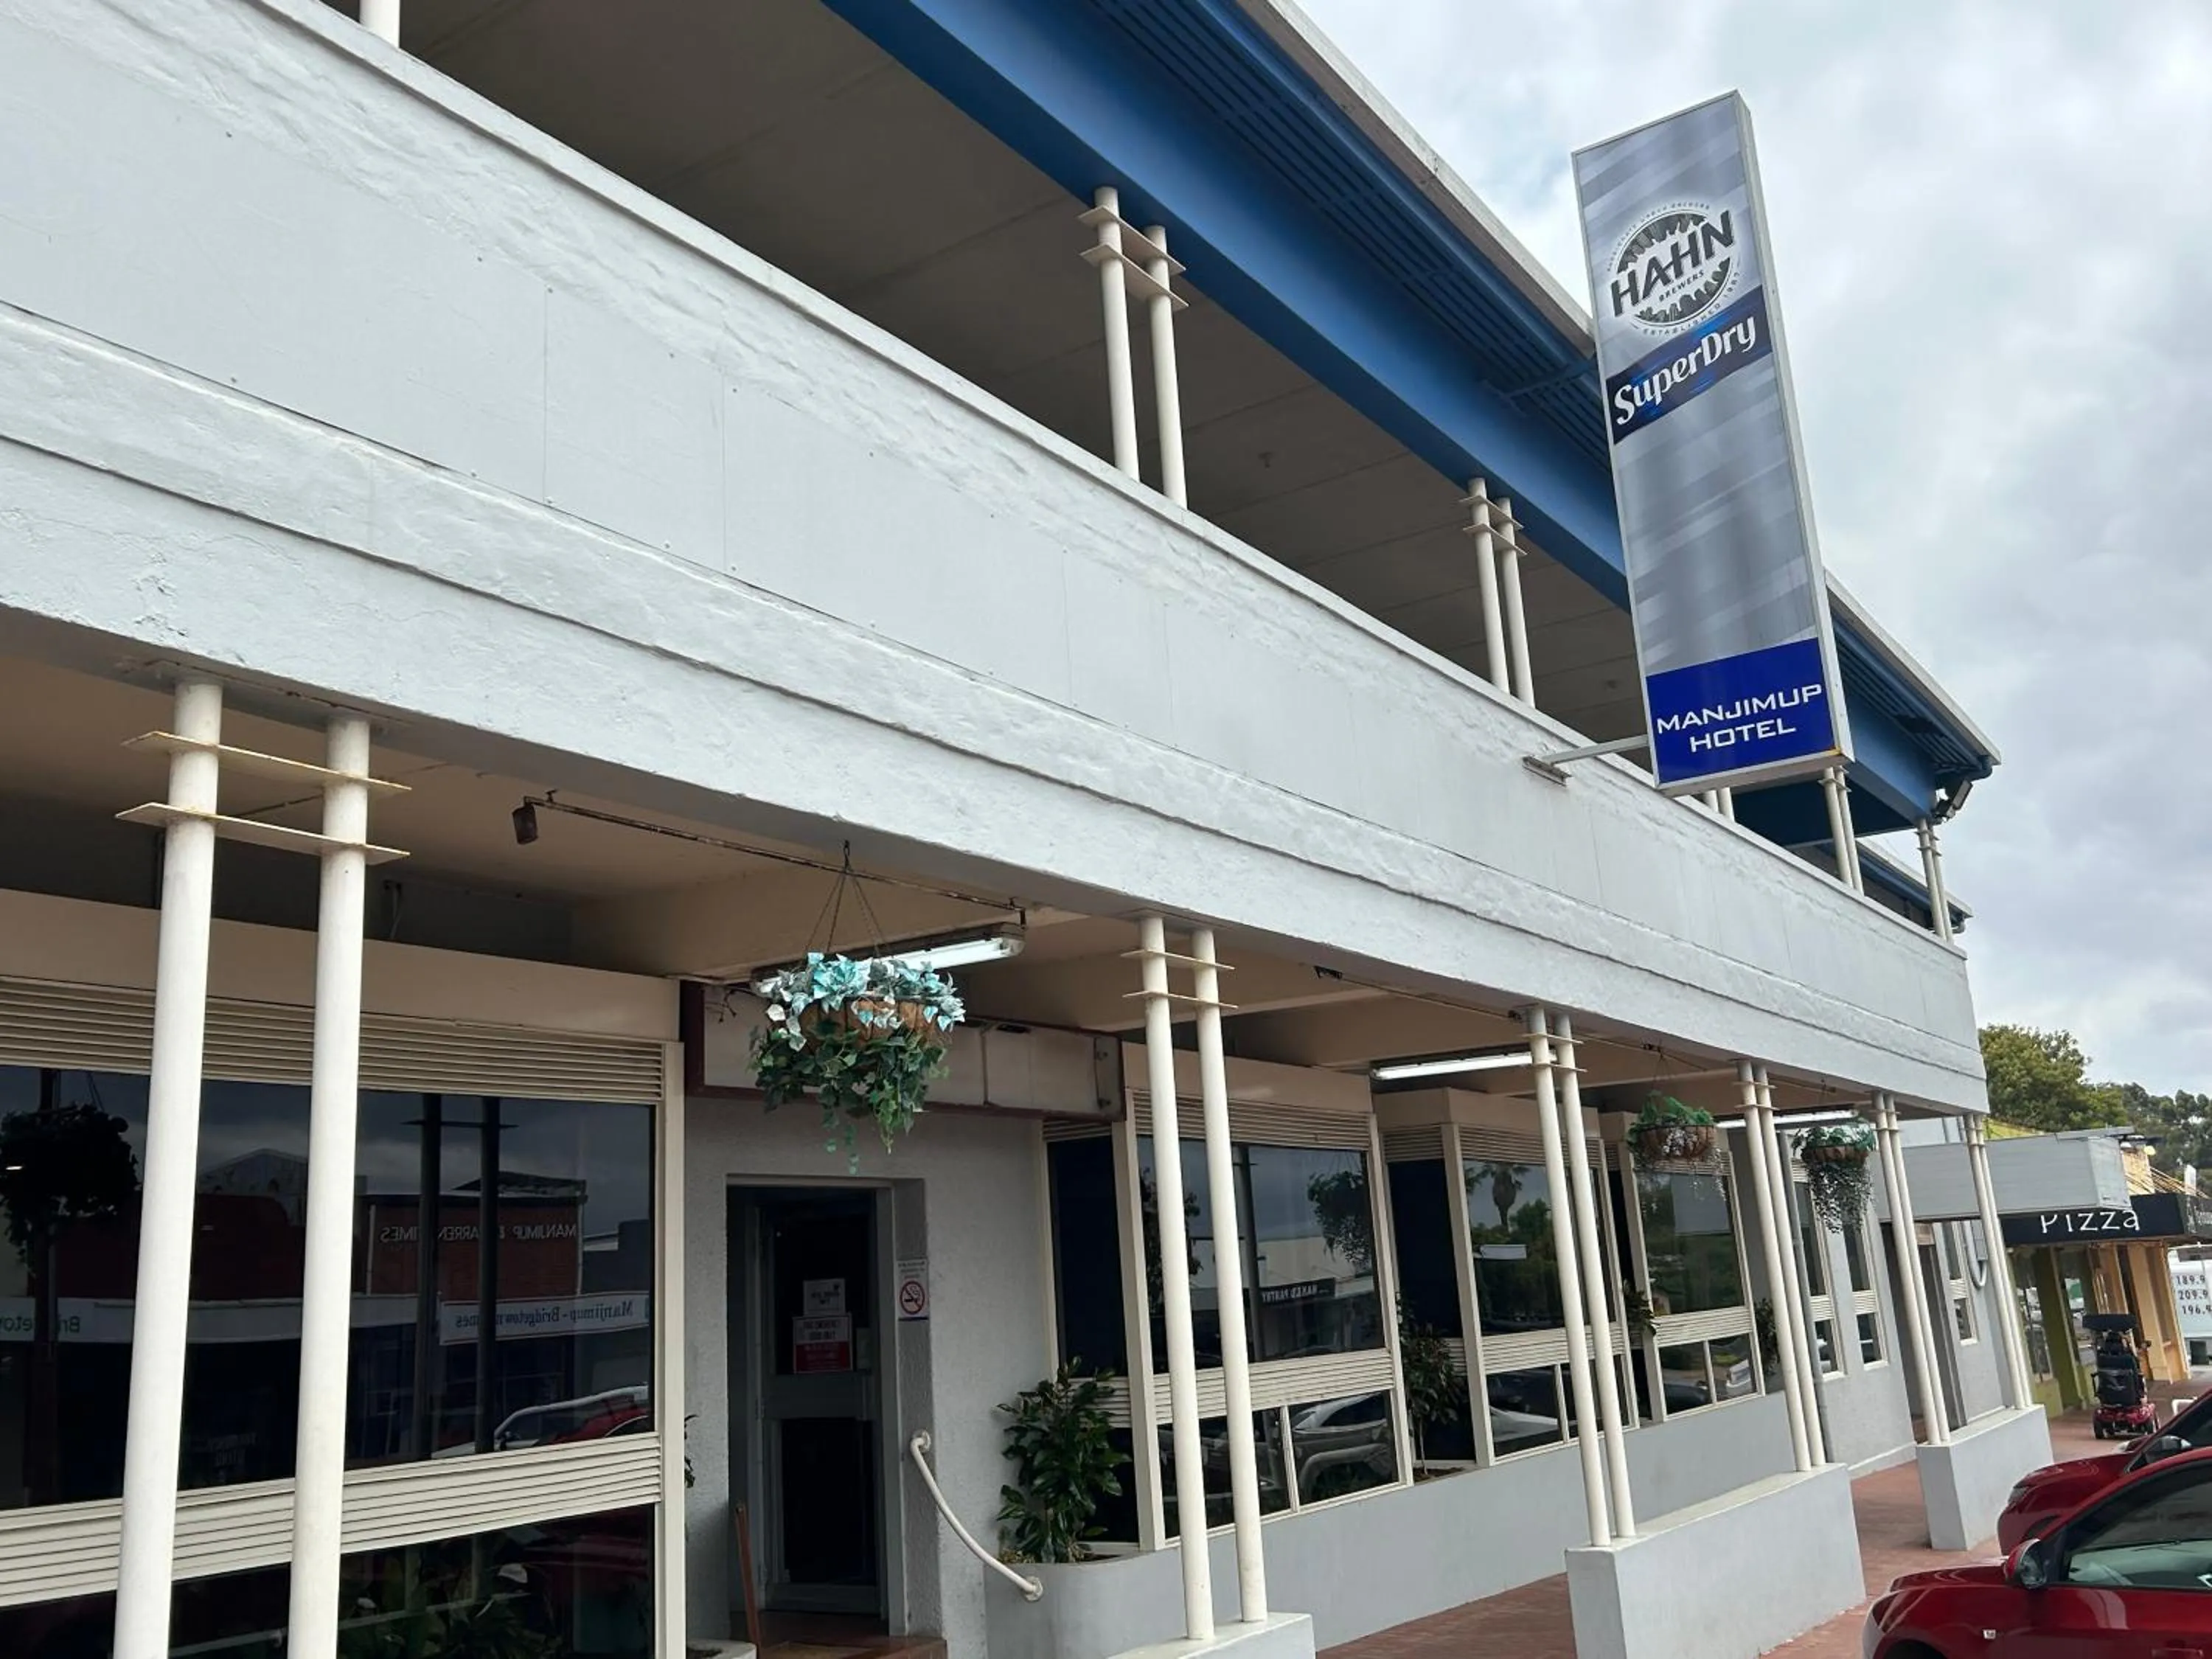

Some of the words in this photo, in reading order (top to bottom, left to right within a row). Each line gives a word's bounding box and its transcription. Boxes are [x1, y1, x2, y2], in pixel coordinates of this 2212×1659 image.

[1611, 210, 1734, 317] HAHN
[1659, 270, 1705, 301] BREWERS
[1614, 316, 1756, 425] SuperDry
[1657, 684, 1823, 734] MANJIMUP
[1689, 717, 1797, 753] HOTEL
